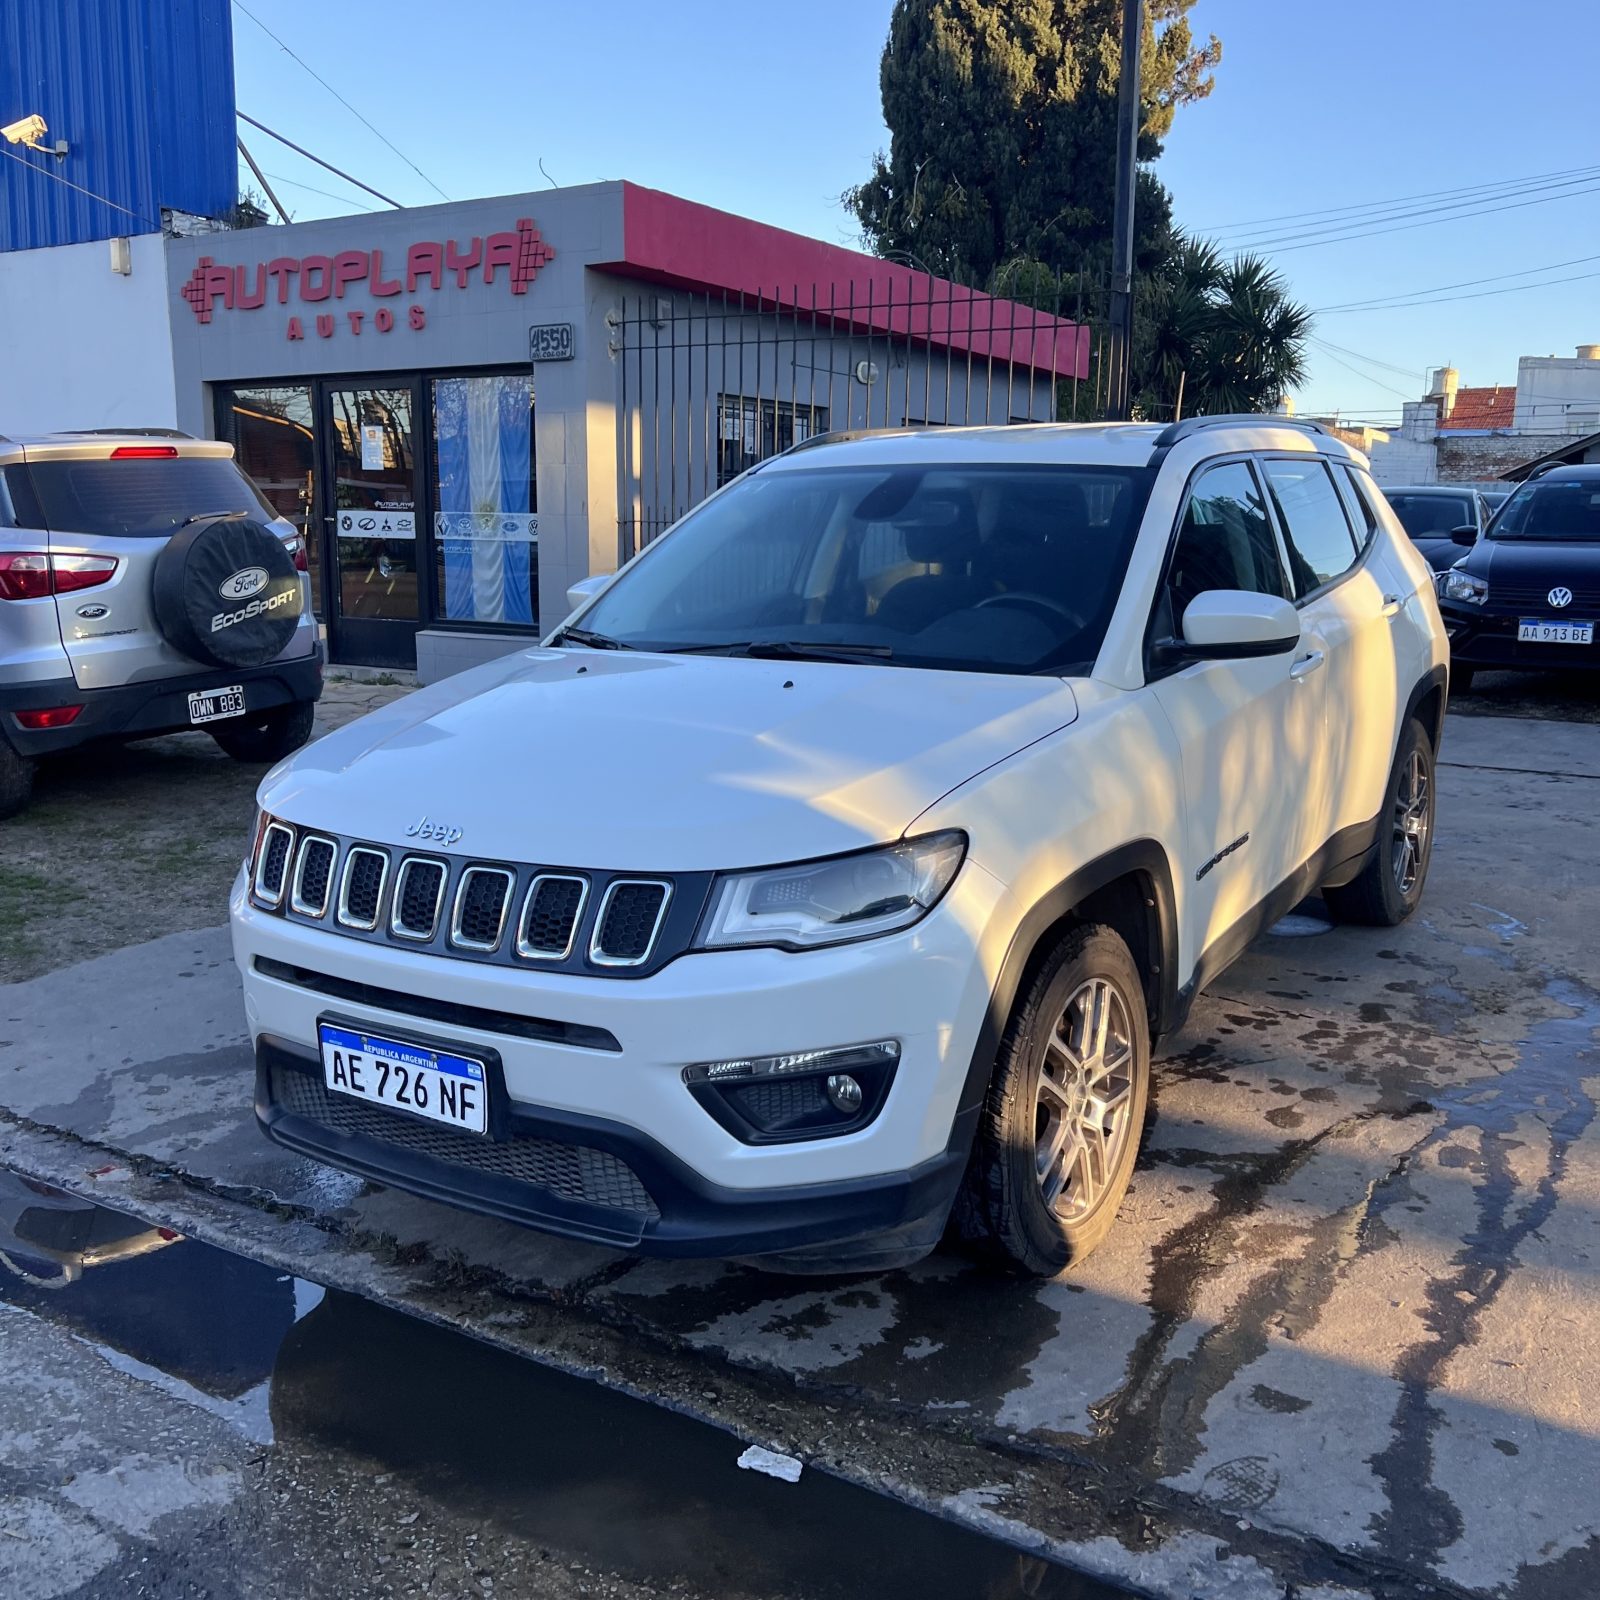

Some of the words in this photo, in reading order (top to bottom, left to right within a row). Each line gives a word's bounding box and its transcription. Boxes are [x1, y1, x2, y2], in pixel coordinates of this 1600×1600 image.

[204, 231, 522, 310] AUTOPLAYA
[286, 304, 427, 341] AUTOS
[531, 328, 570, 351] 4550
[542, 350, 567, 358] COLON
[233, 573, 258, 594] Ford
[1522, 627, 1538, 640] AA
[1543, 628, 1568, 641] 913
[1572, 629, 1589, 642] BE
[191, 698, 215, 718] OWN
[220, 693, 243, 712] 883
[404, 815, 464, 847] Jeep
[363, 1043, 400, 1060] REPUBLICA
[401, 1053, 439, 1070] ARGENTINA
[333, 1050, 365, 1092] AE
[375, 1060, 428, 1109] 726
[439, 1077, 476, 1121] NF
